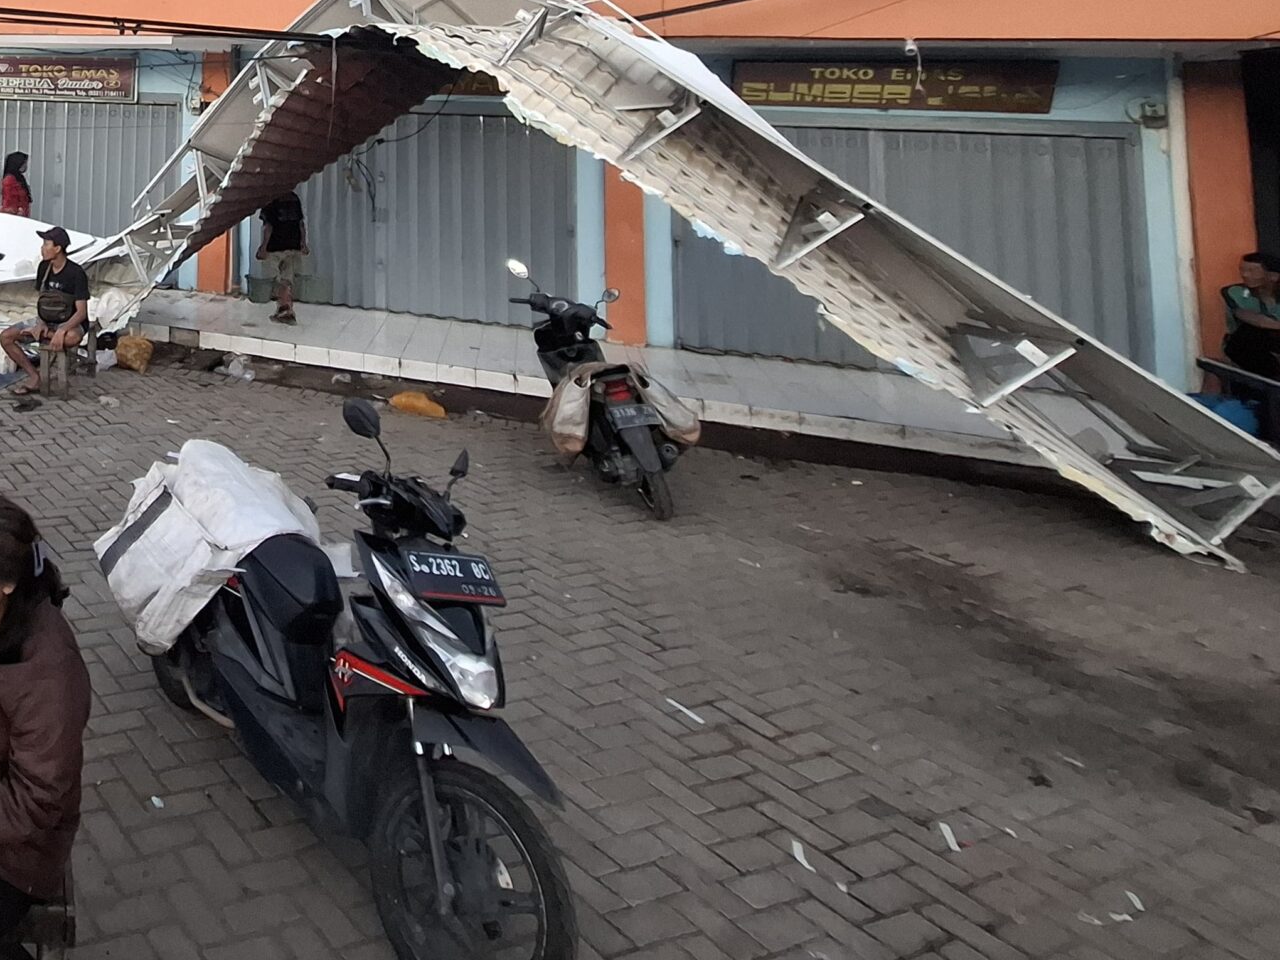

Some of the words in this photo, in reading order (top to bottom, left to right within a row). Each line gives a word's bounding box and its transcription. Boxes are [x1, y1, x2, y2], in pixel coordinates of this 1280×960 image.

[19, 64, 68, 78] TOKO
[72, 66, 120, 79] EMAS
[810, 67, 873, 80] TOKO
[741, 82, 912, 104] SUMBER
[409, 554, 421, 573] S
[429, 557, 464, 578] 2362
[393, 646, 428, 685] HONDA
